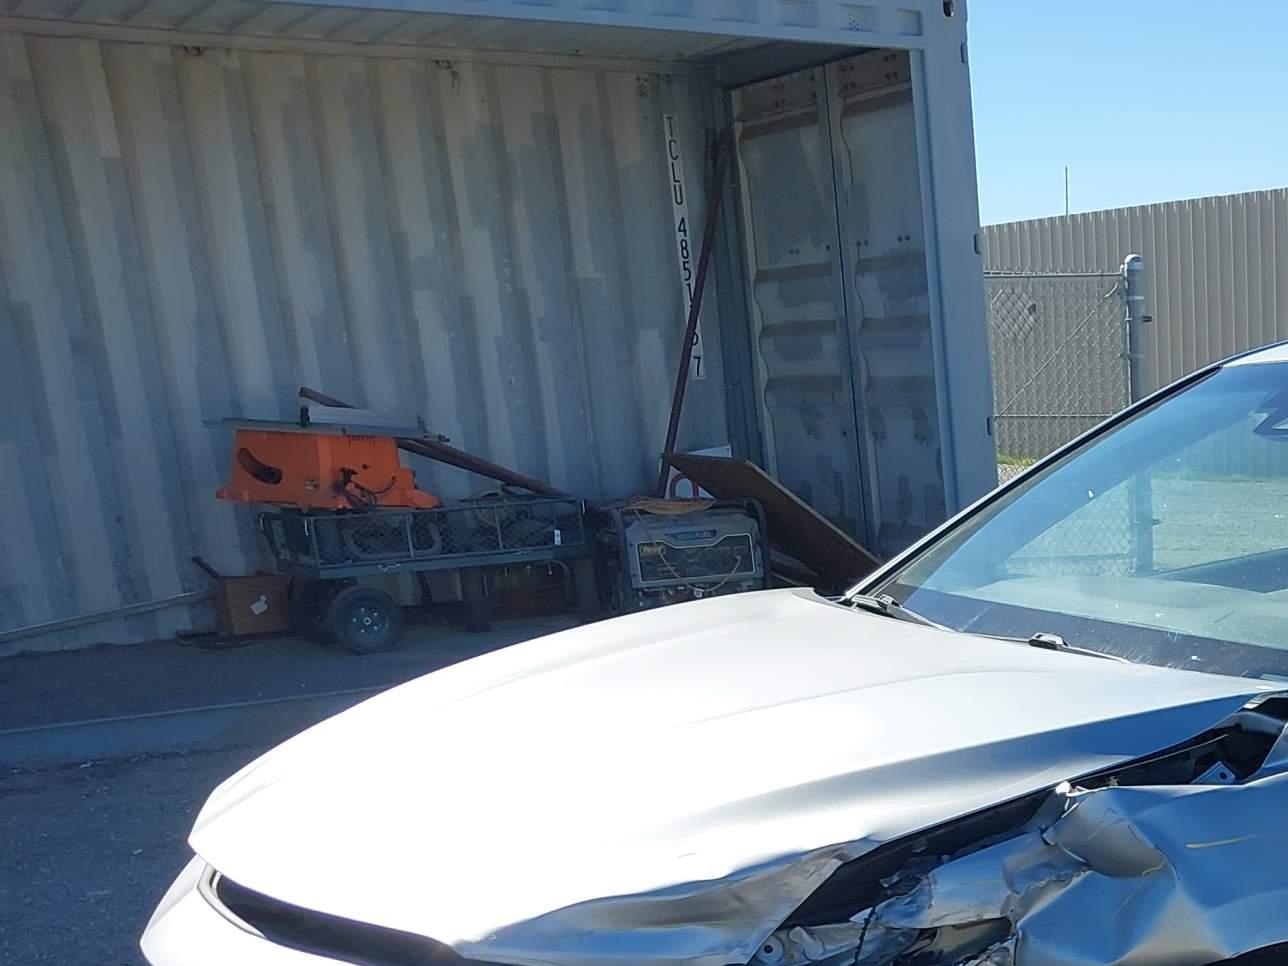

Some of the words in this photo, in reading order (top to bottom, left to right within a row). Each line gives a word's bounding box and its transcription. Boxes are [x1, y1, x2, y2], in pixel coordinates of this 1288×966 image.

[666, 116, 683, 205] TCLU
[678, 216, 699, 346] 4851
[692, 356, 702, 377] 7
